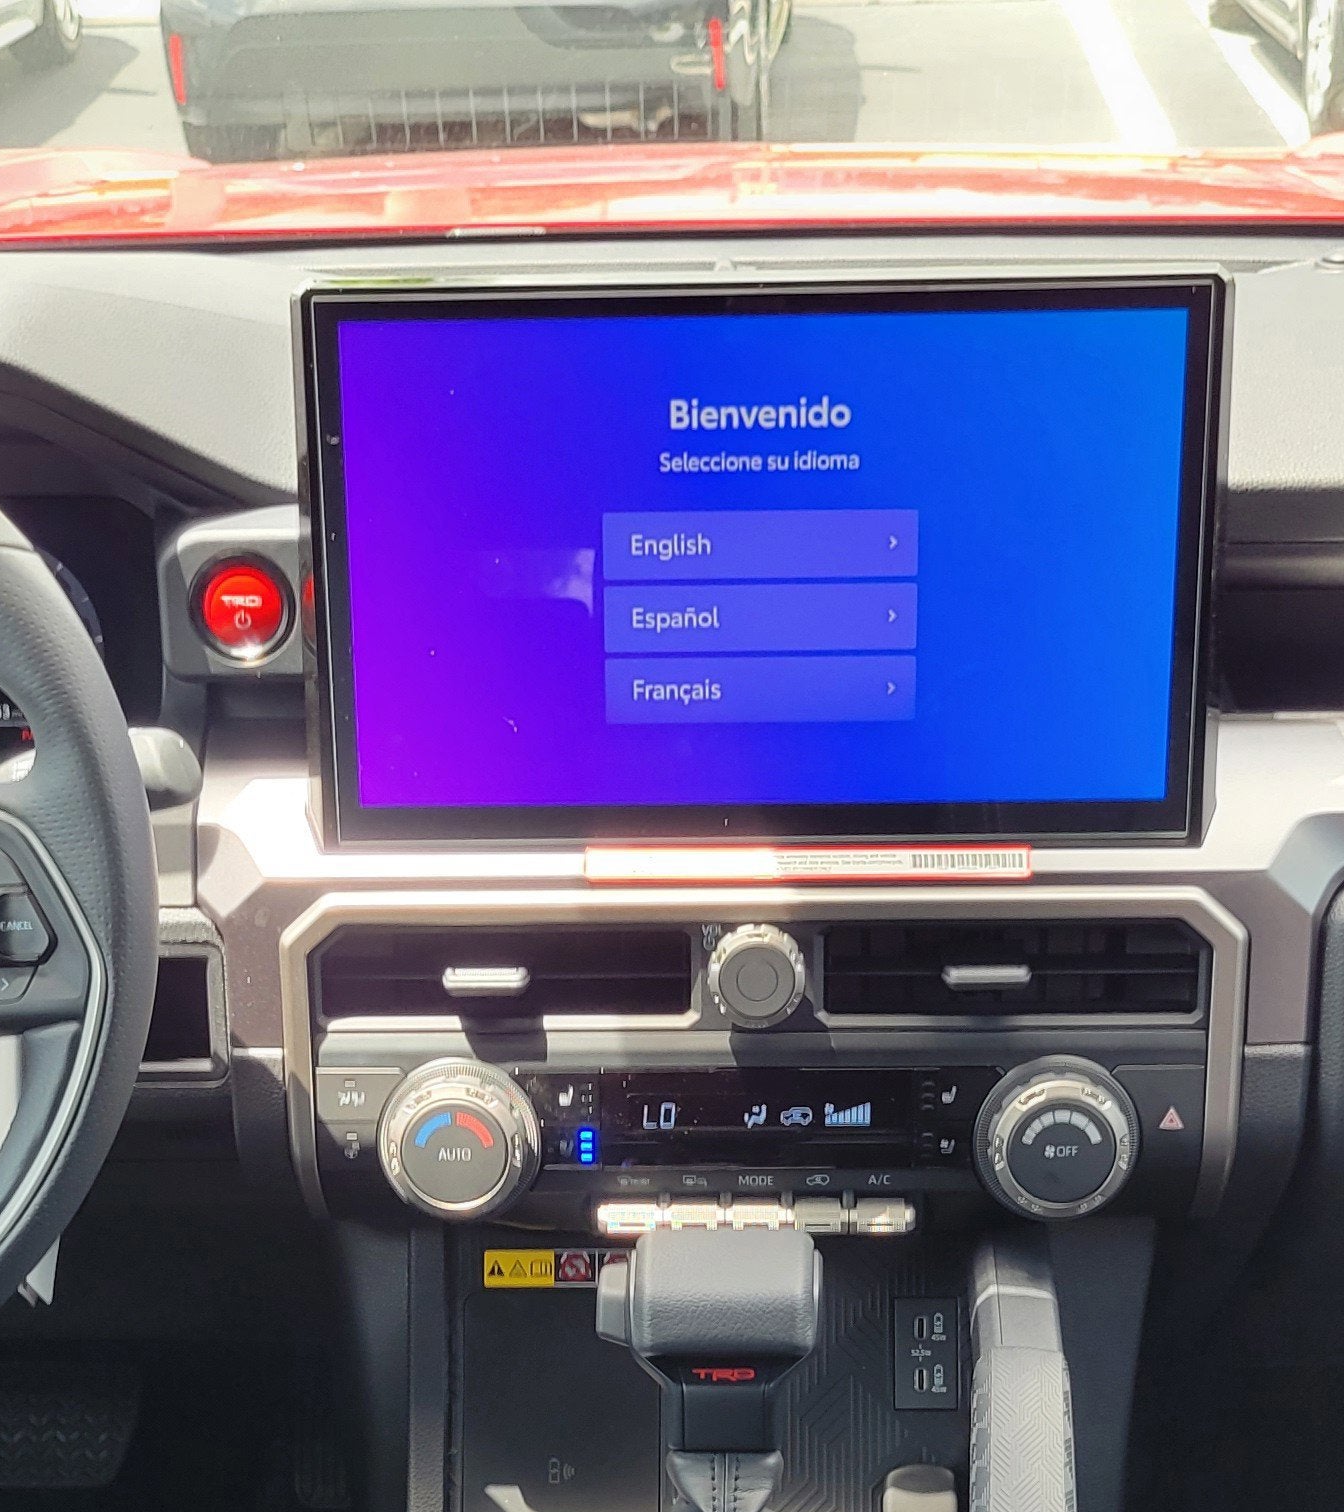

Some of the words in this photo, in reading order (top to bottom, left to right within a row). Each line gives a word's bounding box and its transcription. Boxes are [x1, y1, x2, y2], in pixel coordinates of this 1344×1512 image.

[669, 395, 852, 430] Bienvenido
[659, 451, 763, 473] Seleccione
[767, 456, 789, 472] su
[794, 450, 860, 471] idioma
[630, 533, 712, 561] English
[220, 595, 263, 608] TRD
[631, 606, 720, 633] Español
[632, 679, 721, 705] Français
[0, 920, 34, 931] CANCEL
[438, 1147, 472, 1162] AUTO
[1056, 1145, 1079, 1157] OFF
[738, 1175, 774, 1186] MODE
[867, 1174, 892, 1186] A/C
[691, 1367, 755, 1382] TRD
